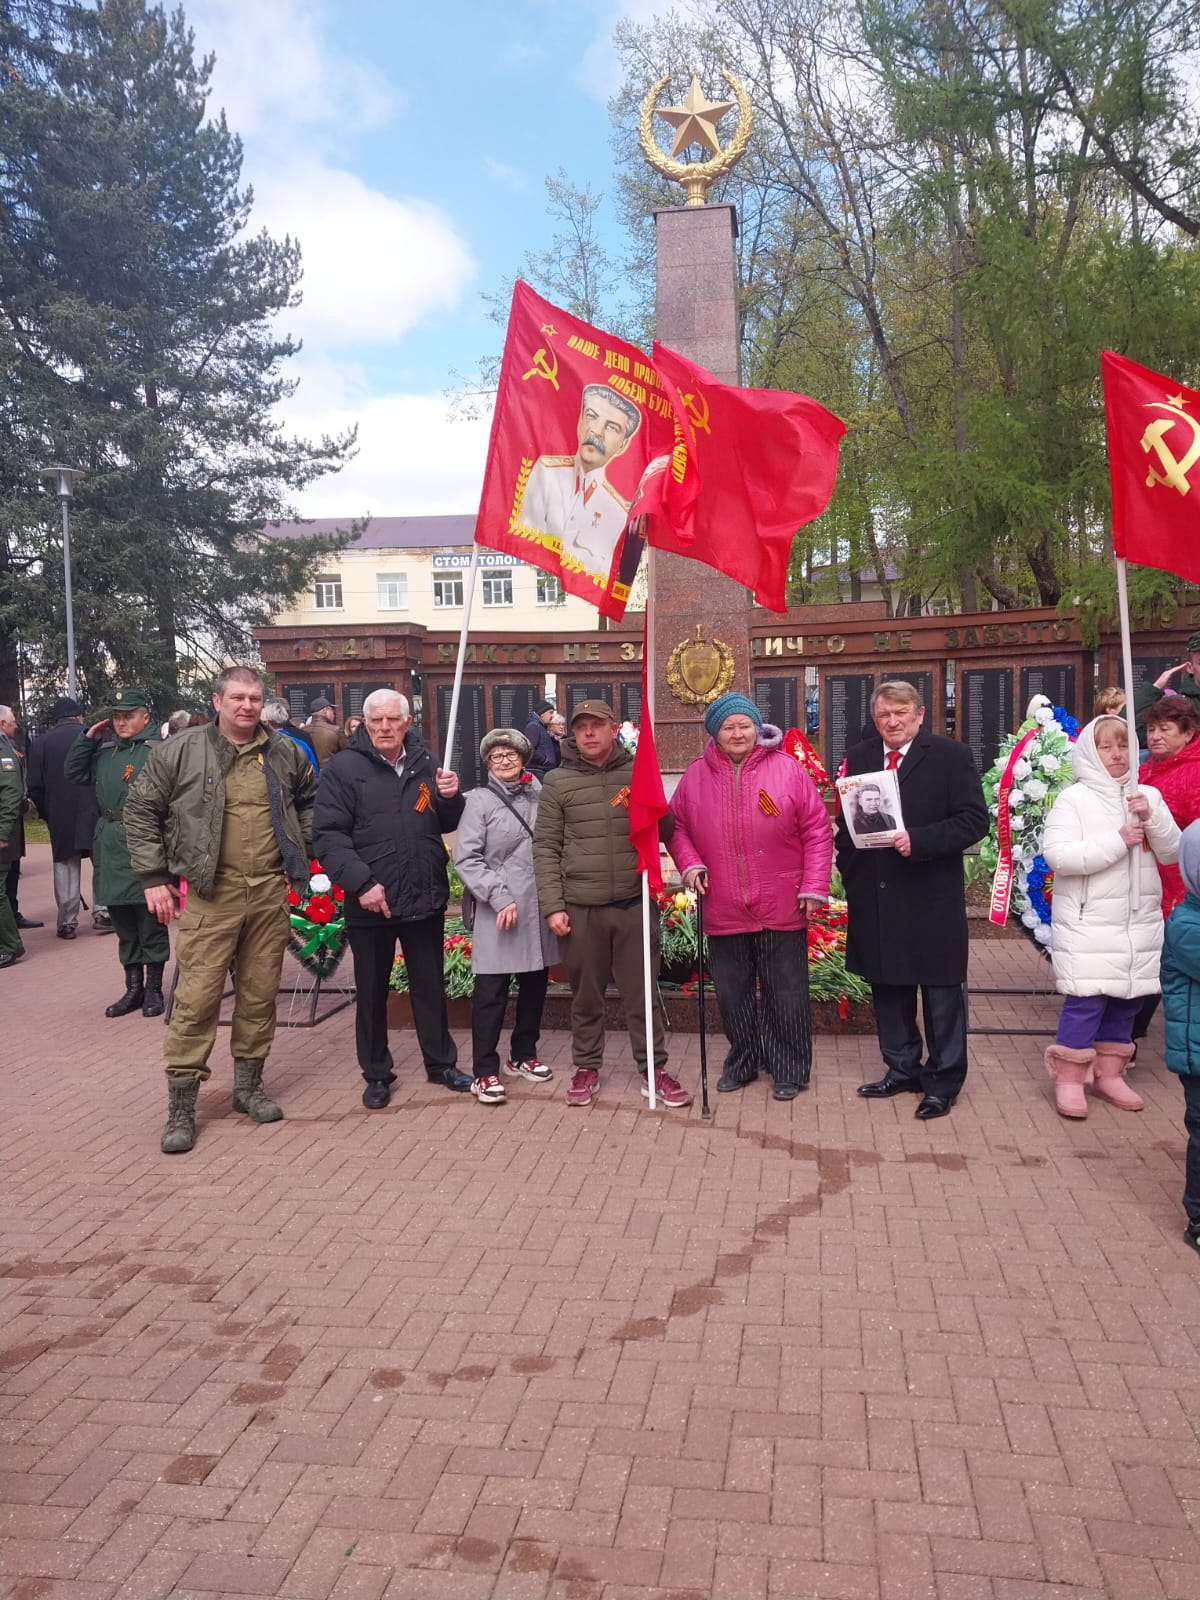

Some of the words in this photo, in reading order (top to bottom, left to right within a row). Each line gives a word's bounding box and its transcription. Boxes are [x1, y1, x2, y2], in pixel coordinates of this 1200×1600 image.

[567, 335, 600, 360] НАШЕ
[649, 392, 673, 419] БУДЕ
[872, 631, 913, 652] НЕ
[944, 622, 1071, 648] ЗАБЫТО
[437, 644, 542, 664] НИКТО
[563, 643, 601, 662] НЕ
[994, 857, 1010, 898] СОВЕТА
[992, 898, 1004, 912] ОТ
